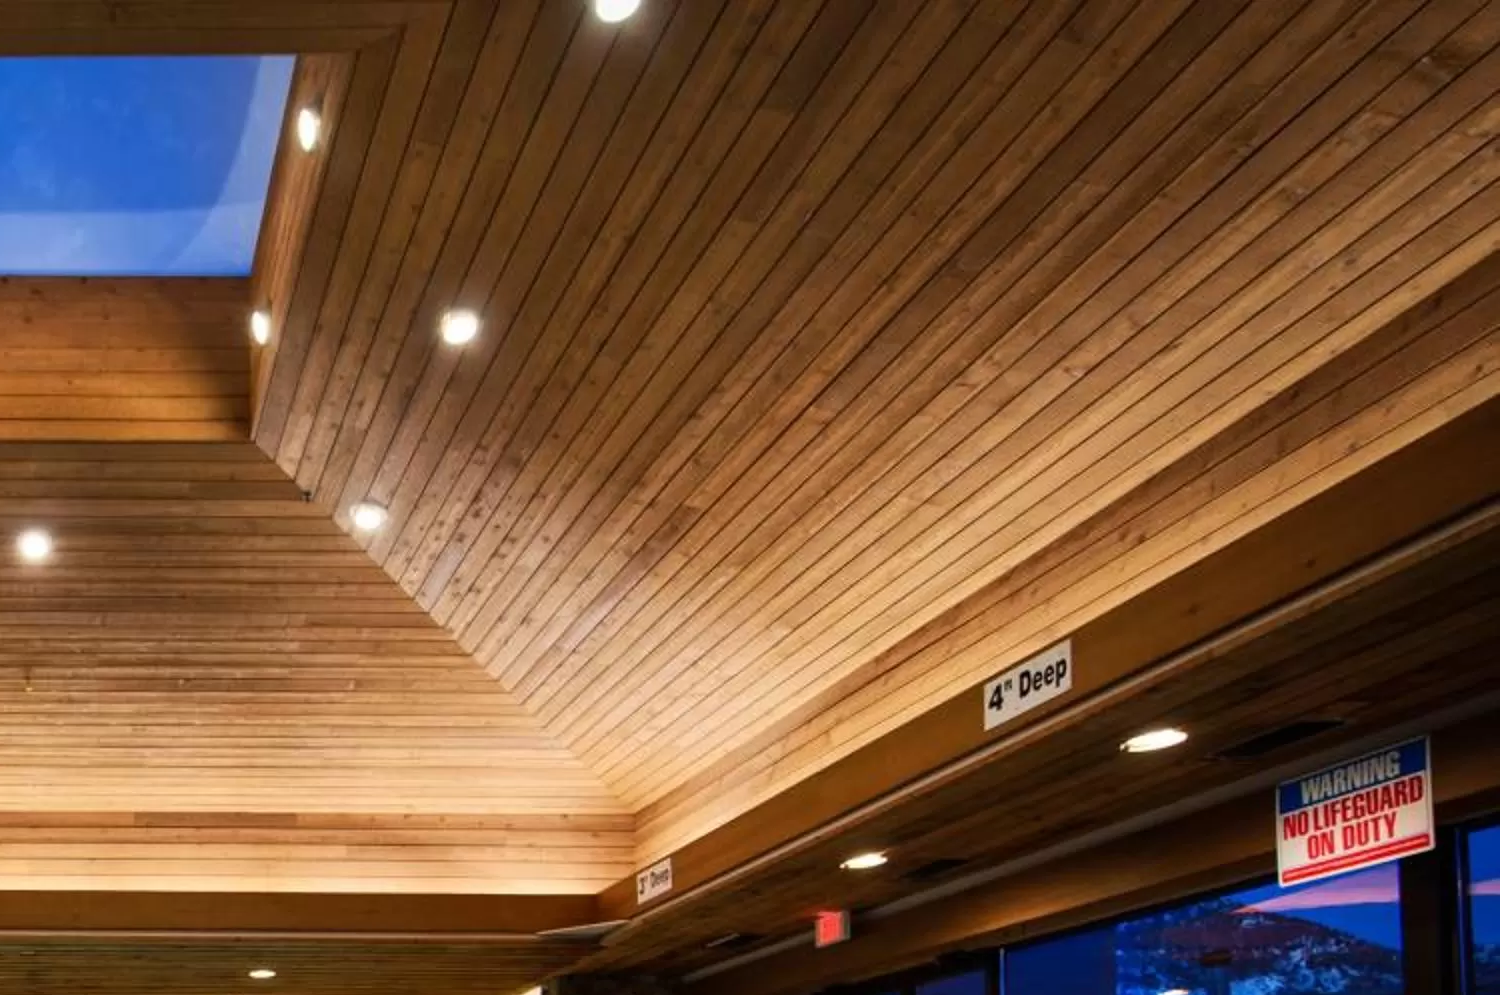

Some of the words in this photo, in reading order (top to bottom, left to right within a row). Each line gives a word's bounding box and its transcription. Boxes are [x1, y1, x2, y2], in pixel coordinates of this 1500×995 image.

[1019, 658, 1067, 699] Deep
[1301, 751, 1400, 804] WARNING
[1283, 812, 1309, 841] NO
[1314, 775, 1424, 831] LIFEGUARD
[1307, 830, 1334, 860] ON
[1342, 812, 1397, 850] DUTY
